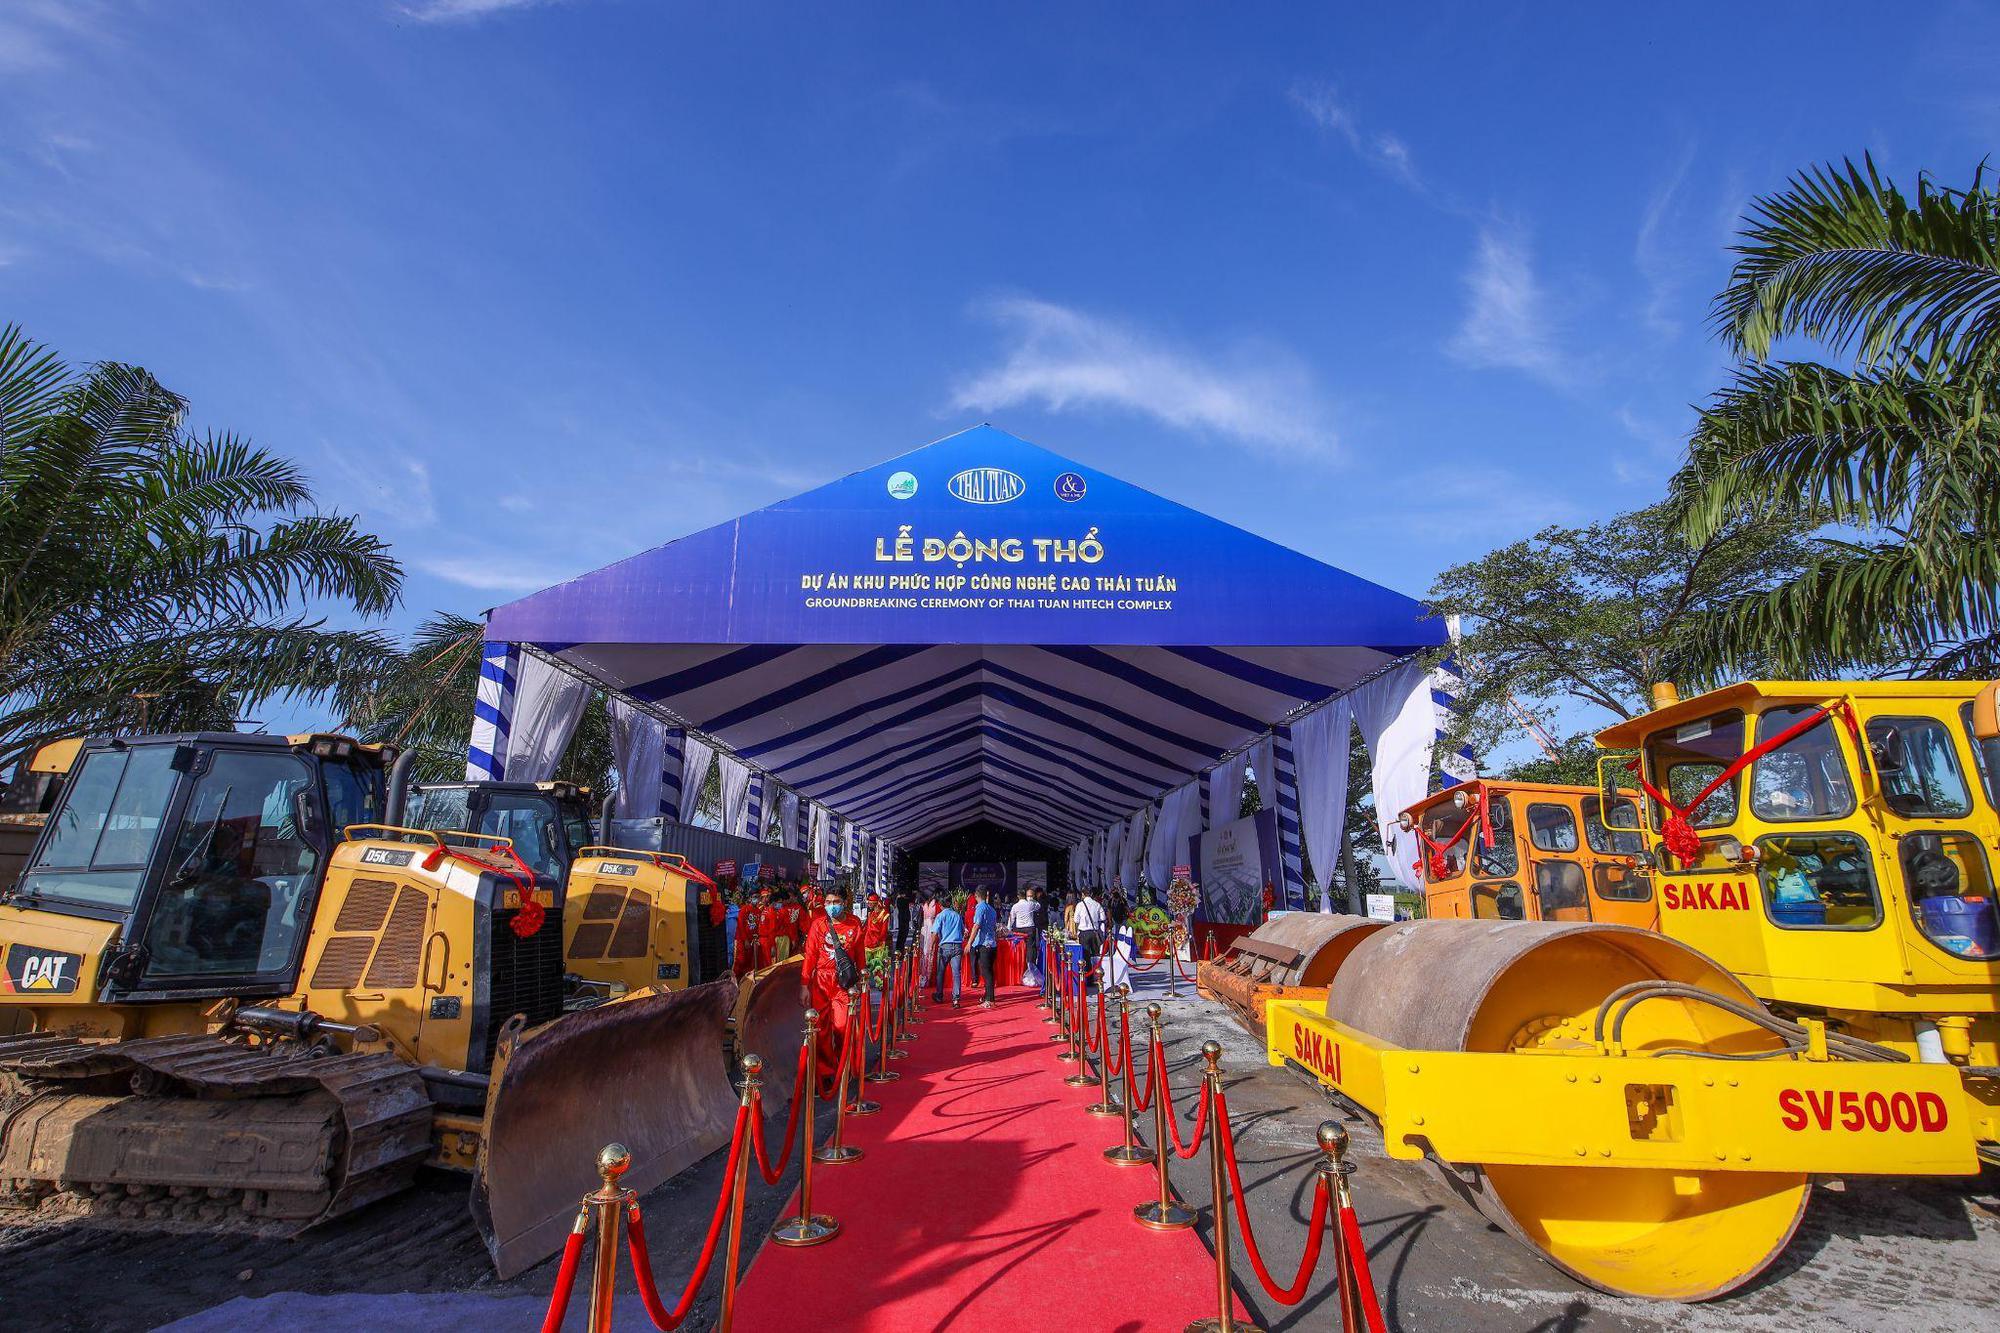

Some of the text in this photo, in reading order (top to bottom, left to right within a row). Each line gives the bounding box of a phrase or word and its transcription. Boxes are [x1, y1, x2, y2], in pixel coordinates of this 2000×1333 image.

[957, 470, 1018, 502] THAI TUAN
[875, 524, 1104, 569] LỄ ĐỘNG THỔ
[801, 573, 1177, 593] DỰ ÁN KHU PHỨC HỢP CÔNG NGHỆ CAO THÁI TUẤN
[805, 598, 1172, 610] GROUNDBREAKING CEREMONY OF THAI TUAN HITECH COMPLEX
[1663, 882, 1751, 911] SAKAI
[21, 955, 68, 989] CAT
[1294, 1022, 1342, 1086] SAKAI
[1778, 1088, 1949, 1133] SV500D
